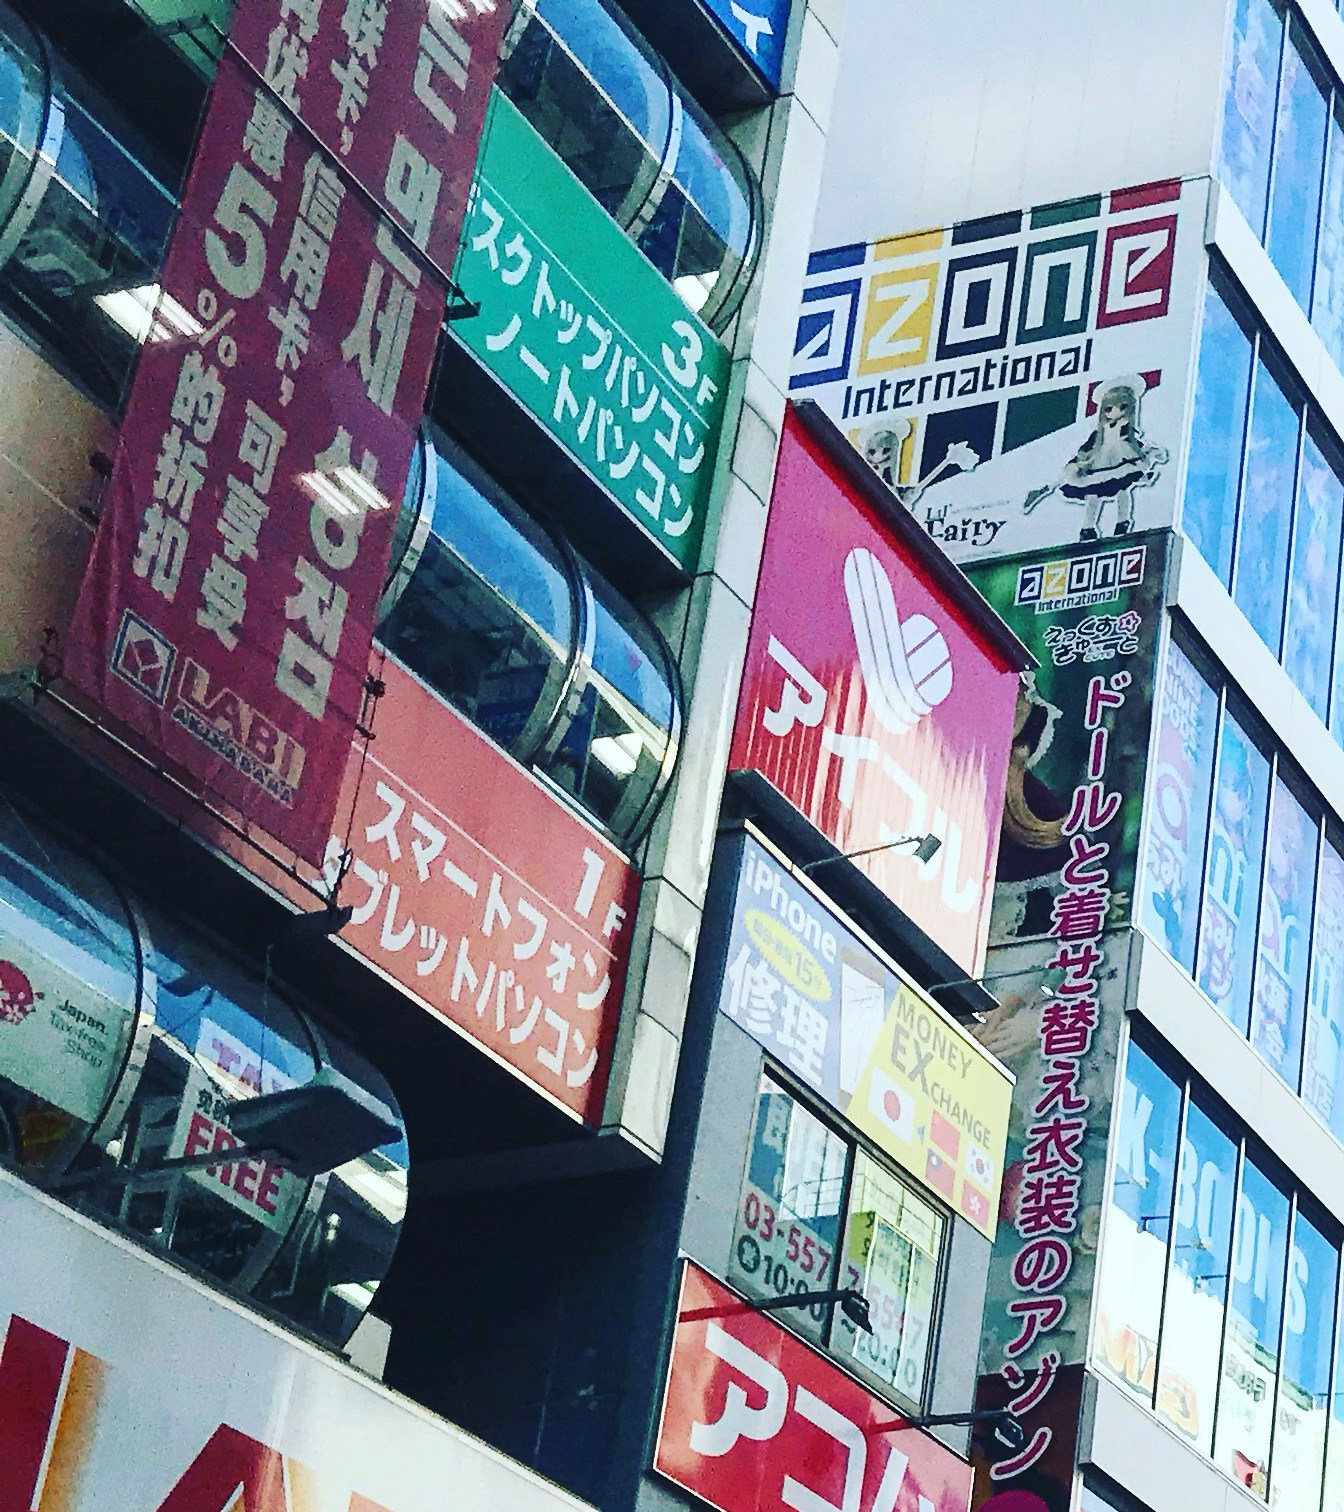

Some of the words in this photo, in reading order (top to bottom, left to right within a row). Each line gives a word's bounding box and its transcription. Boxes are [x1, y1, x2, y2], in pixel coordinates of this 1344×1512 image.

[465, 182, 706, 476] スクトップパソコン
[658, 319, 717, 410] 3F
[841, 338, 1094, 421] International
[486, 311, 695, 539] ノートパソコン
[1016, 547, 1147, 605] azone
[1036, 587, 1118, 613] International
[762, 635, 980, 914] アイフル
[367, 779, 612, 1010] スマートフォン
[574, 847, 627, 938] 1F
[744, 849, 839, 966] iPhone
[66, 1040, 104, 1069] Shop
[726, 941, 831, 1089] 修理
[896, 993, 973, 1081] MONEY
[890, 1022, 993, 1151] EXCHANGE
